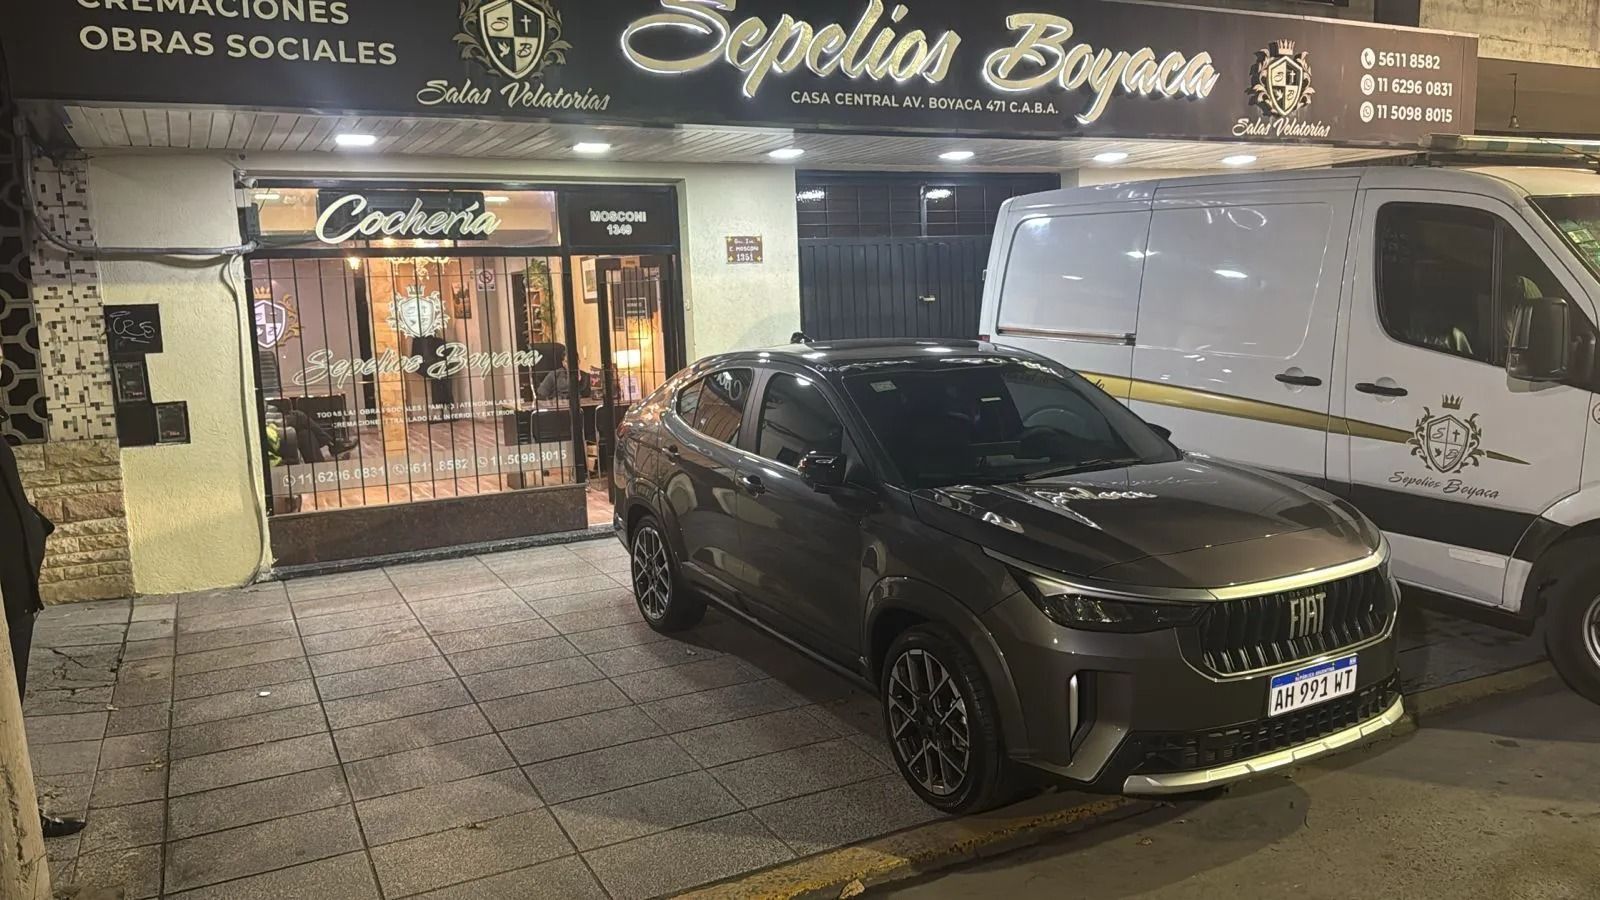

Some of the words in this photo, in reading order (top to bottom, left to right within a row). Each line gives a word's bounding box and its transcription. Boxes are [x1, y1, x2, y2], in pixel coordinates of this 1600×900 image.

[79, 25, 214, 56] OBRAS
[226, 34, 398, 65] SOCIALES
[621, 0, 962, 98] Sepelios
[983, 12, 1220, 124] Boyaca
[1378, 51, 1407, 68] 5611
[1409, 53, 1441, 70] 8582
[416, 78, 492, 105] Salas
[1377, 77, 1388, 92] 11
[1391, 78, 1423, 95] 6296
[1425, 81, 1453, 97] 0831
[790, 91, 831, 105] CASA
[834, 92, 899, 108] CENTRAL
[902, 96, 925, 109] AV.
[928, 97, 983, 112] BOYACA
[985, 100, 1006, 112] 471
[1008, 101, 1059, 115] C.A.B.A.
[1376, 104, 1388, 119] 11
[1390, 105, 1422, 121] 5098
[1425, 107, 1453, 123] 8015
[1231, 117, 1271, 137] Salas
[315, 194, 502, 245] Cochería
[590, 210, 647, 222] MOSCONI
[736, 253, 755, 262] 1351
[291, 347, 424, 389] Sepelios
[426, 342, 544, 380] Boyaca
[386, 404, 422, 413] SOCALES
[332, 419, 385, 429] CREMACIONE
[1442, 478, 1500, 500] Boyaca
[1289, 591, 1327, 641] FIAT
[1274, 685, 1295, 712] AH
[1300, 676, 1328, 704] 991
[1334, 668, 1353, 694] WT
